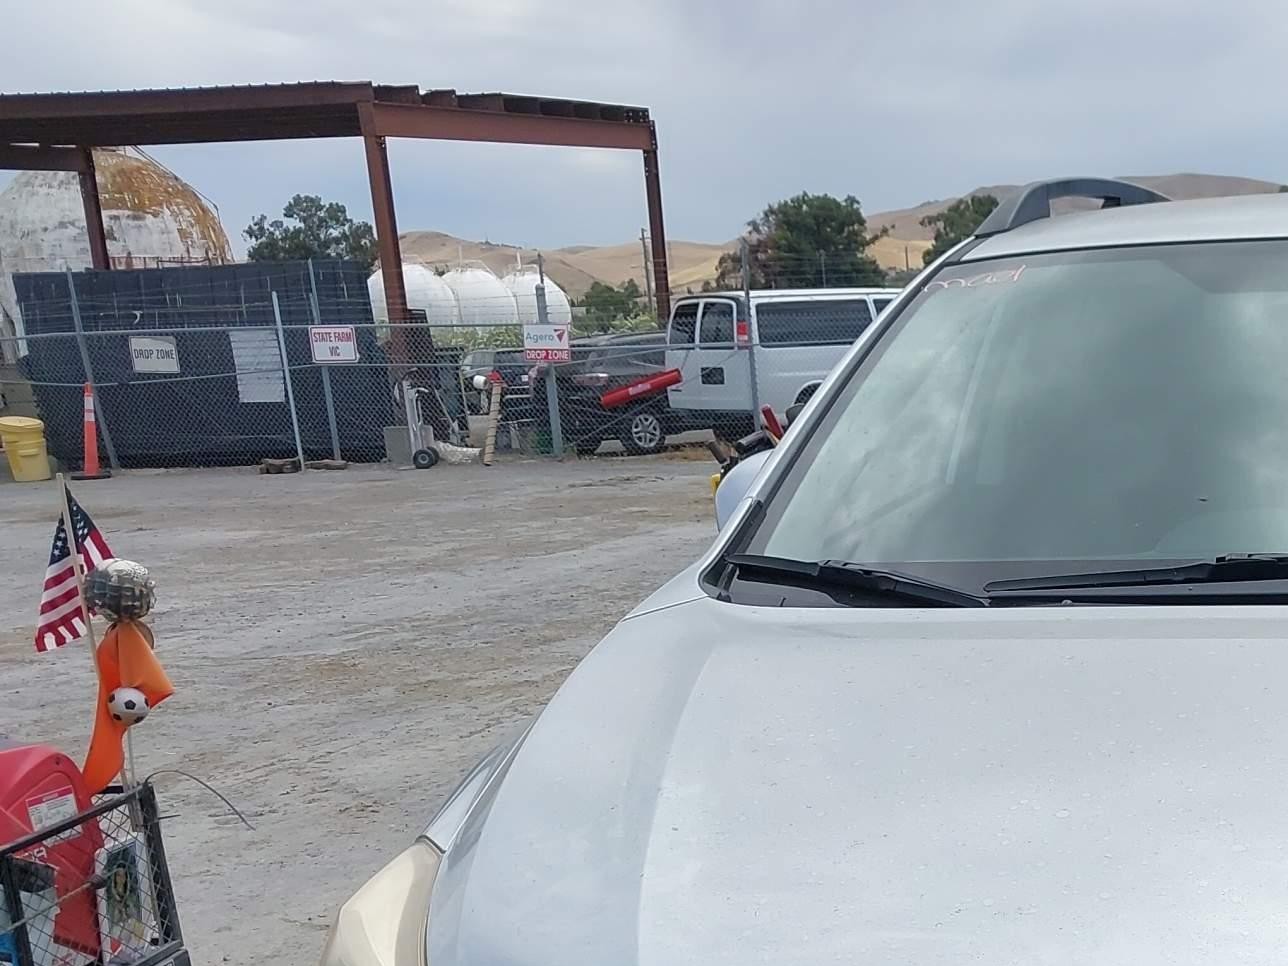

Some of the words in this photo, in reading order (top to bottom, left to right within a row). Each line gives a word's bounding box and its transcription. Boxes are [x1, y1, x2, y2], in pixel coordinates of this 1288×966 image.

[313, 332, 333, 342] STATE
[333, 331, 352, 342] FARM
[526, 332, 554, 343] Agero
[133, 348, 154, 360] DROP
[155, 348, 175, 360] ZONE
[328, 345, 341, 357] VIC
[526, 350, 546, 360] DROP
[547, 350, 569, 360] ZONE
